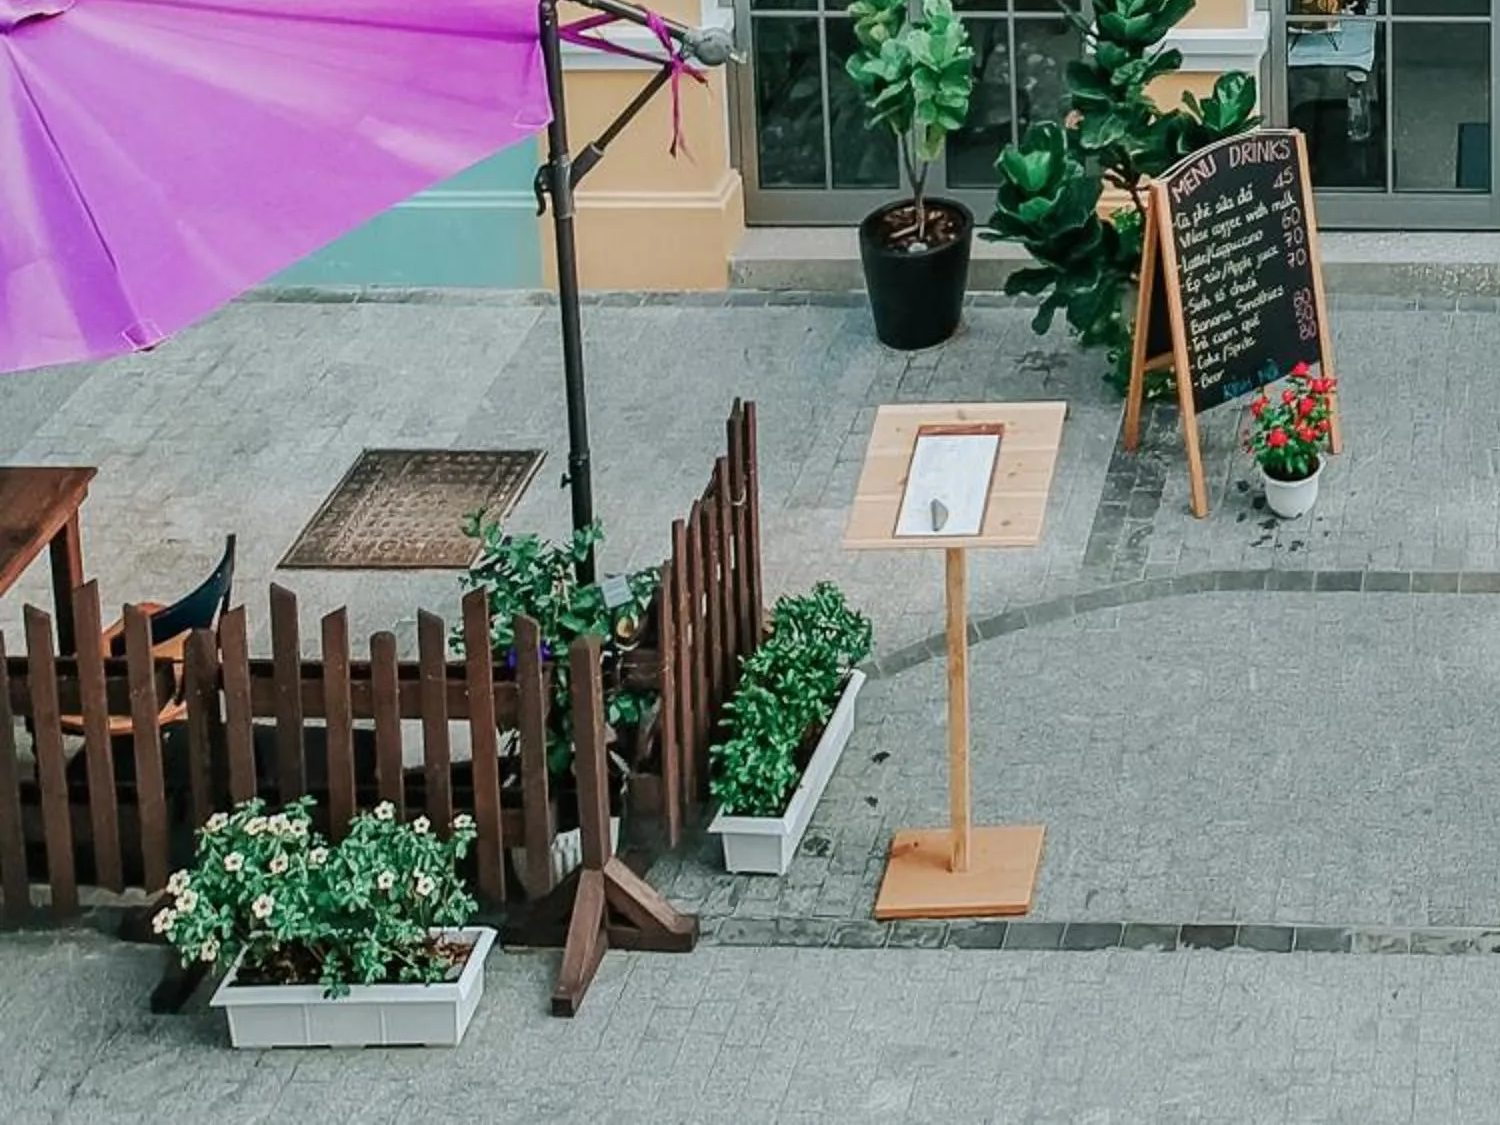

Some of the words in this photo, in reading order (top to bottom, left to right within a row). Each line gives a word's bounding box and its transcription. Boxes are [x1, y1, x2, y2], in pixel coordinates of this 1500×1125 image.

[1171, 154, 1217, 204] MENU
[1228, 136, 1291, 168] DRINKS
[1272, 165, 1295, 189] 45
[1211, 216, 1243, 239] coffee
[1245, 200, 1269, 223] with
[1271, 189, 1297, 212] milk
[1281, 206, 1302, 230] 60
[1283, 226, 1305, 248] 70
[1286, 247, 1307, 268] 70
